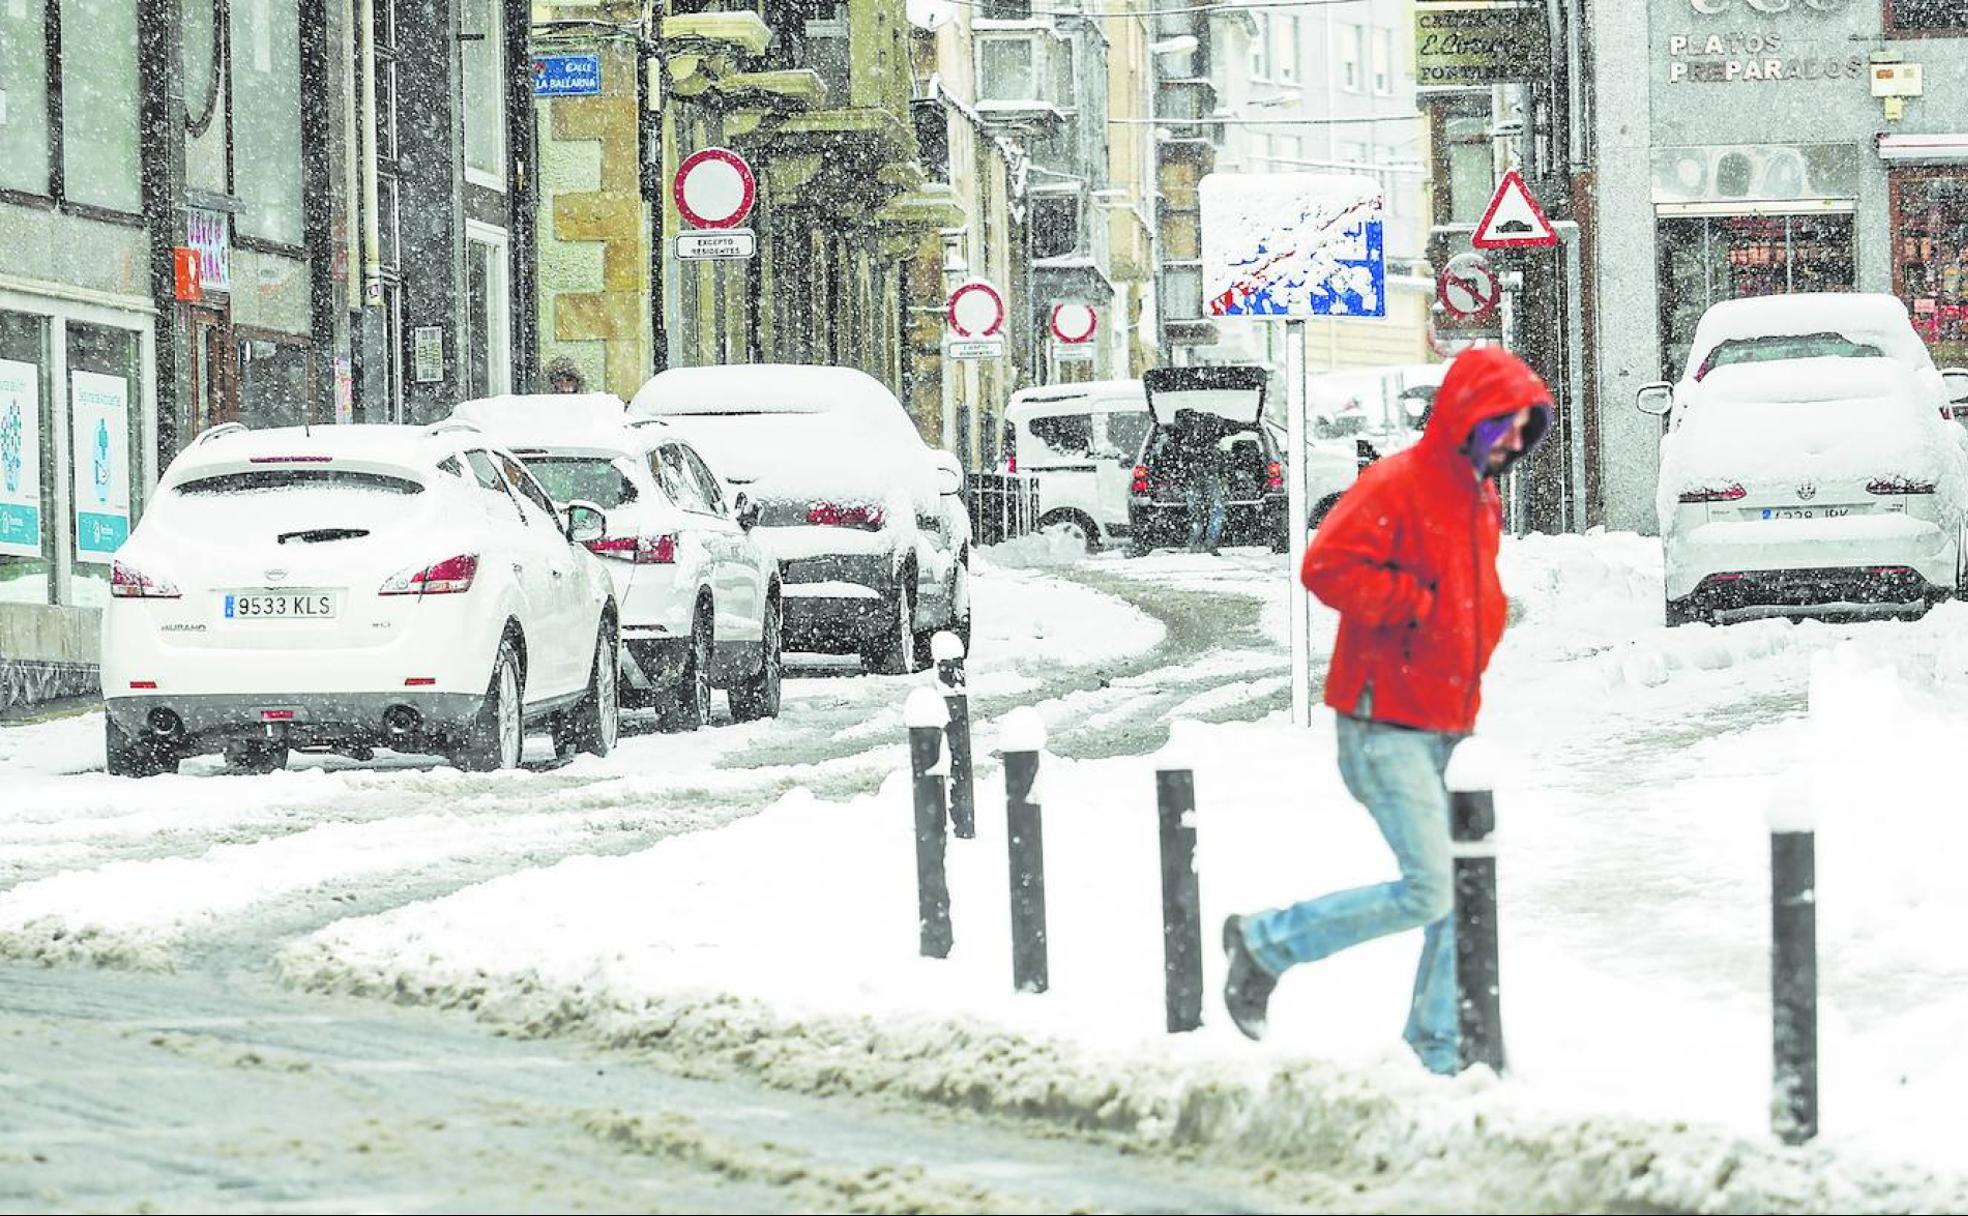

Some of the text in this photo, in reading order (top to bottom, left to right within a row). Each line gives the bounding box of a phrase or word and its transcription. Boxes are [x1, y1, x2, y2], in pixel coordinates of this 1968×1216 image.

[1670, 32, 1782, 56] PLATOS
[565, 60, 593, 73] CALLE
[1670, 56, 1864, 83] PREPARADOS
[536, 79, 548, 89] LA
[697, 238, 734, 247] EXCEPTO
[690, 247, 740, 256] RESIDENTES
[238, 596, 330, 616] 9533 KLS
